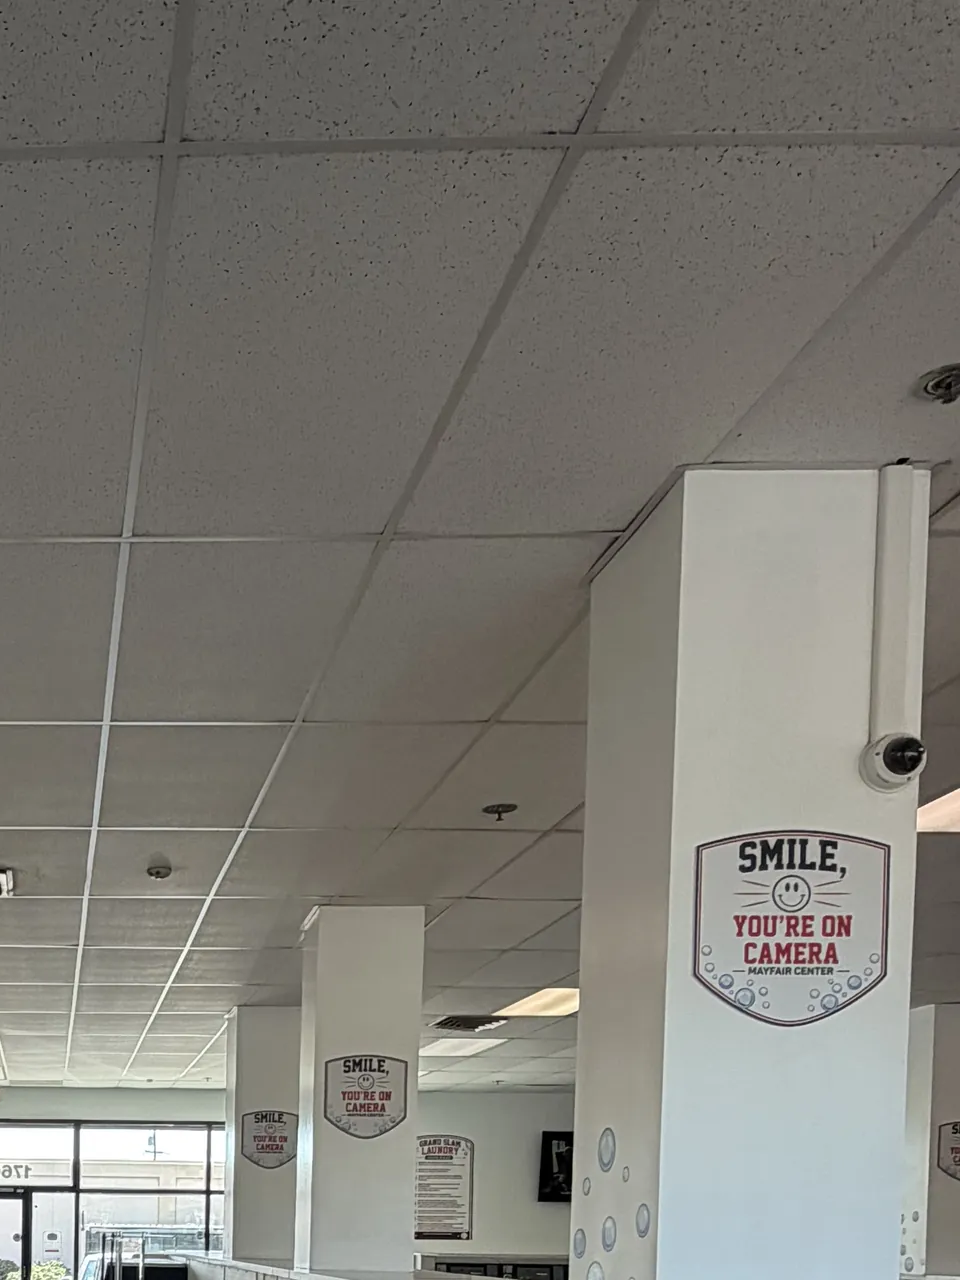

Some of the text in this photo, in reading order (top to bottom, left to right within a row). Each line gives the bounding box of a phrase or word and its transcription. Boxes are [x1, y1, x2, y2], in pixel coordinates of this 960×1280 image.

[739, 838, 846, 878] SMILE,
[733, 915, 852, 937] YOU'RE ON
[744, 942, 839, 964] CAMERA
[747, 966, 834, 975] MAYFAIR CENTER
[343, 1058, 389, 1076] SMILE,
[341, 1091, 392, 1101] YOU'RE ON
[345, 1102, 386, 1113] CAMERA
[254, 1112, 286, 1126] SMILE,
[420, 1139, 461, 1148] GRAND SLAM
[421, 1146, 459, 1155] LAUNDRY
